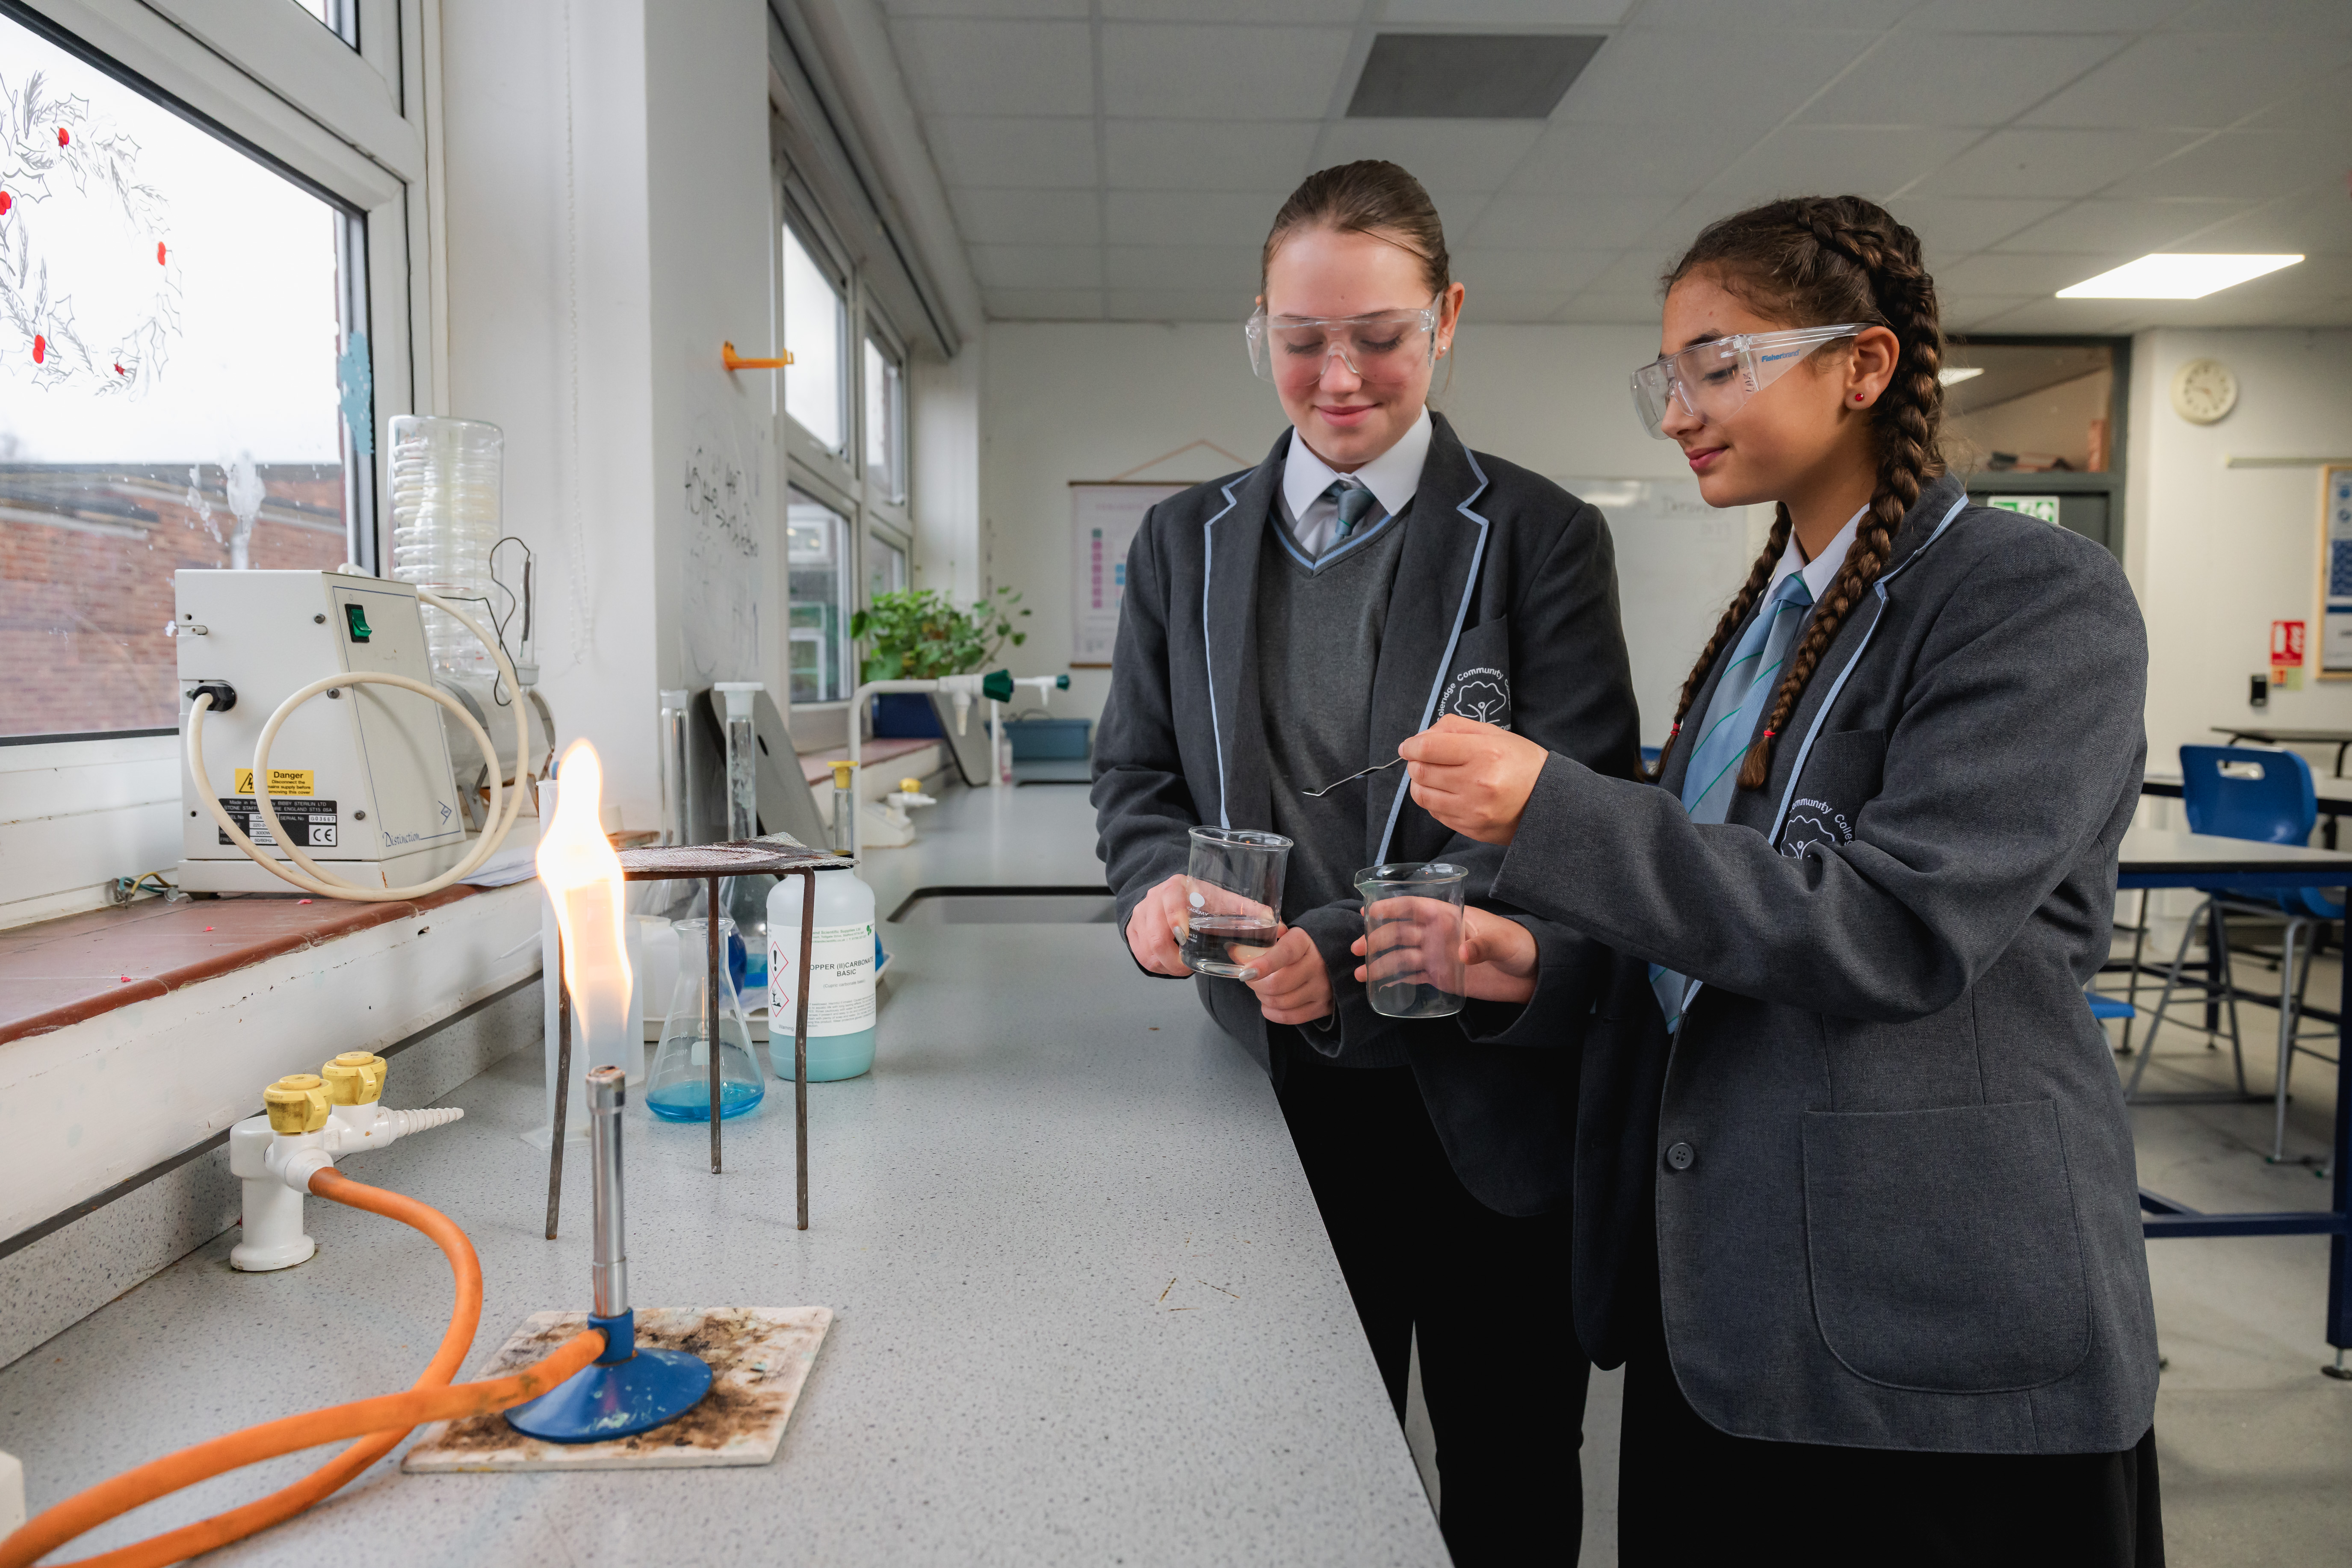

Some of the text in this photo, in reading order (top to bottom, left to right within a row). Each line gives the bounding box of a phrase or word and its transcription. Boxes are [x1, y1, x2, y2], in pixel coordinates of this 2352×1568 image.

[1761, 350, 1799, 363] Fisherbrand
[1457, 667, 1504, 681] Community
[274, 771, 304, 780] Danger
[1789, 798, 1854, 845] ommunity Colle
[383, 832, 420, 847] Distinction
[1187, 906, 1209, 916] CADEMY
[1189, 923, 1200, 931] 50ml
